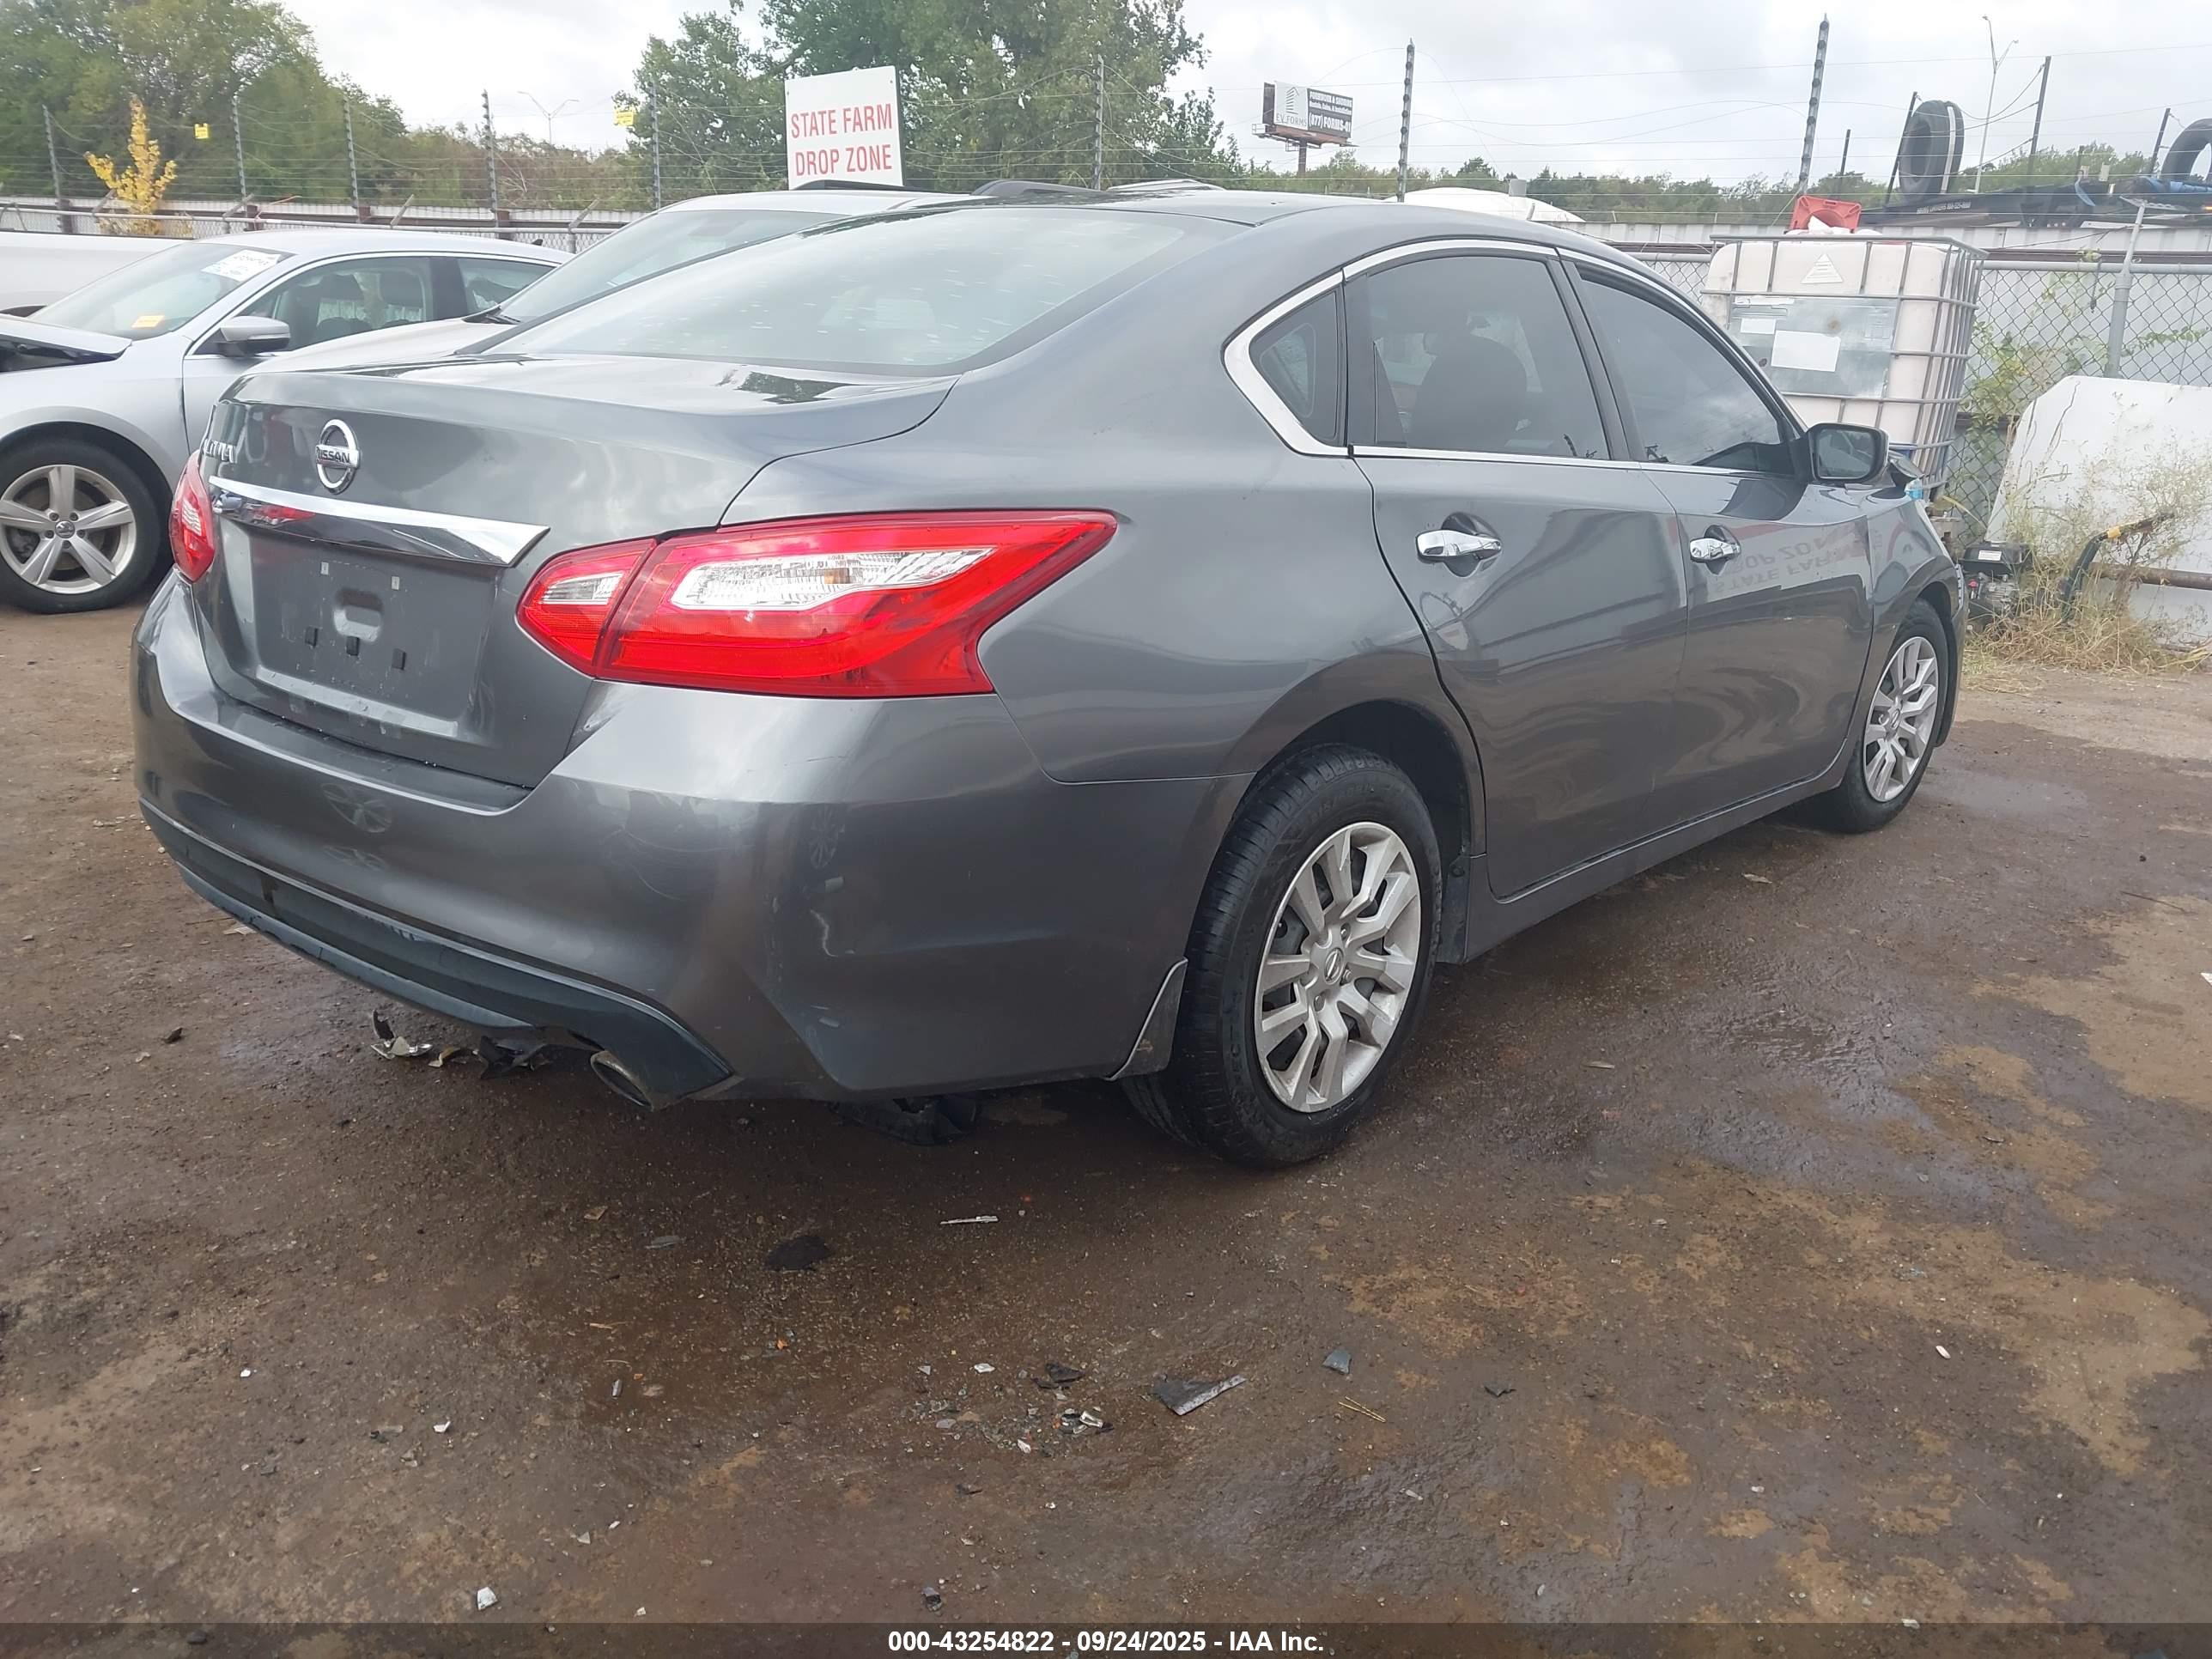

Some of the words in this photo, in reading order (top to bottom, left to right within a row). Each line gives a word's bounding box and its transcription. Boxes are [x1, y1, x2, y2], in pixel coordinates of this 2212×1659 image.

[791, 110, 838, 139] STATE
[842, 103, 893, 133] FARM
[795, 149, 840, 176] DROP
[846, 144, 893, 173] ZONE
[316, 446, 350, 464] NISSAN
